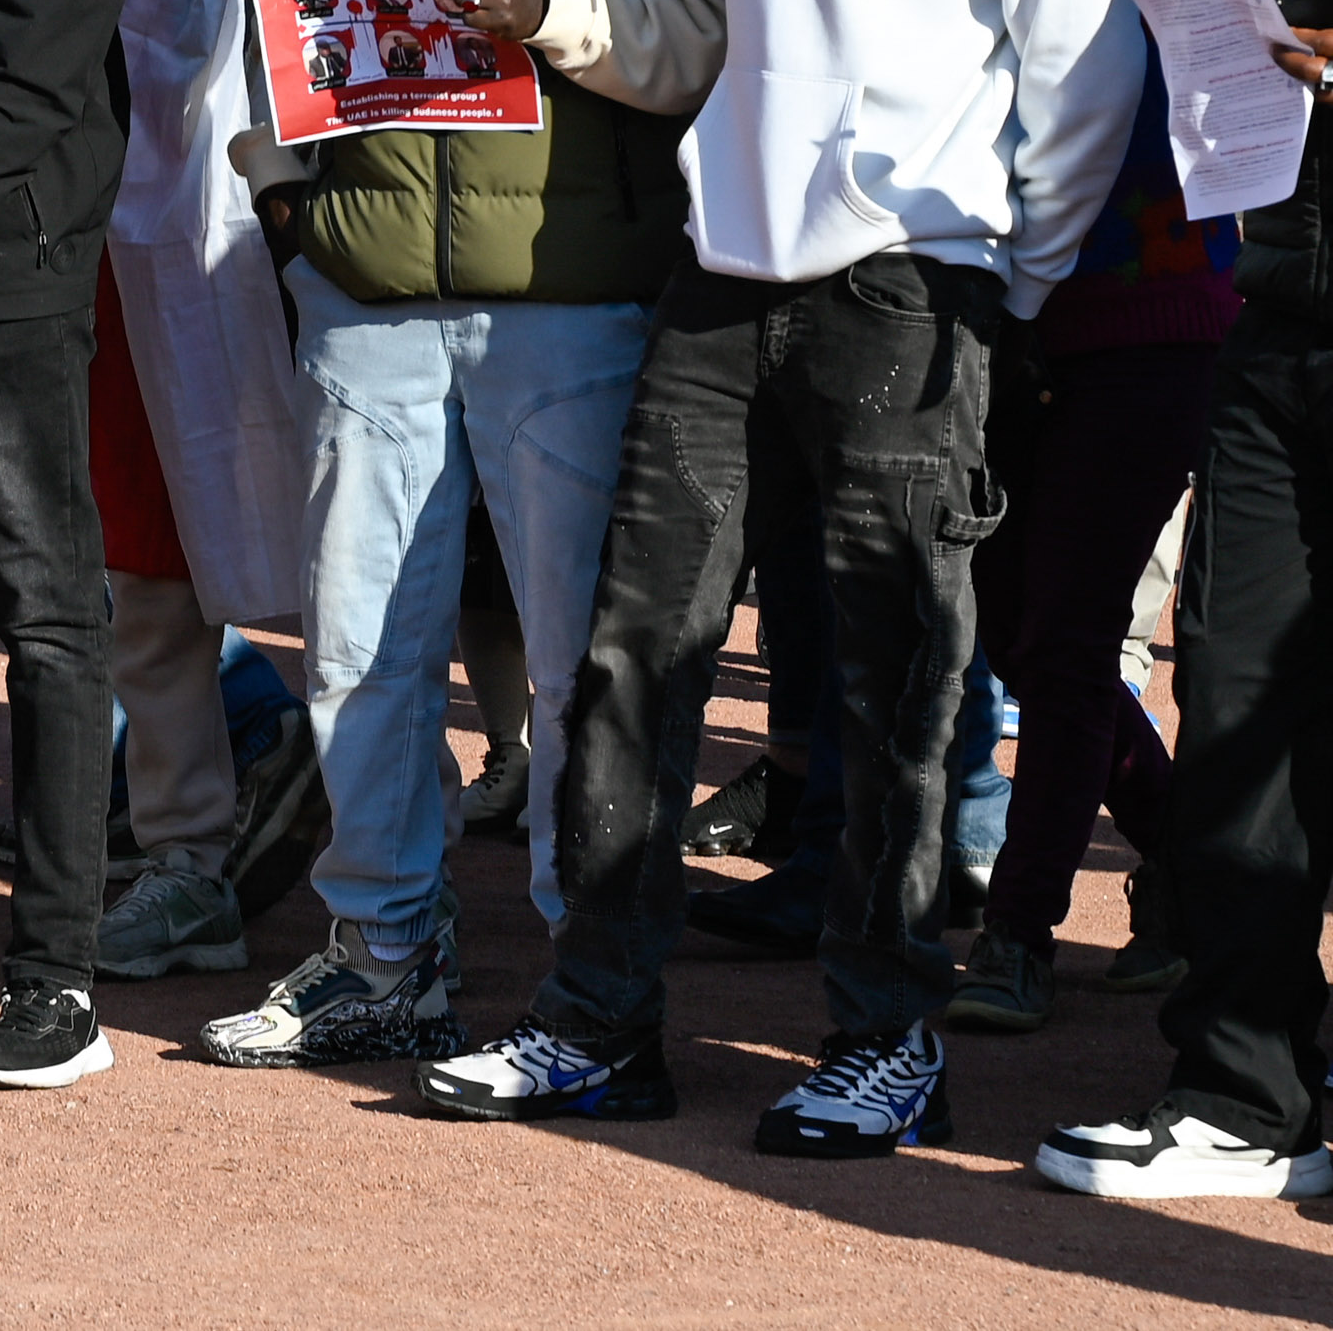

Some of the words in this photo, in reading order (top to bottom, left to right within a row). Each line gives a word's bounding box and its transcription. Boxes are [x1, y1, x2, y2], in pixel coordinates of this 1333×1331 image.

[340, 91, 400, 109] Establishing
[410, 91, 449, 101] terrorist
[450, 92, 478, 103] group
[326, 116, 345, 127] The
[347, 111, 368, 122] UAE
[370, 109, 379, 118] is
[381, 107, 411, 118] killing
[412, 106, 458, 118] Sudanese
[460, 107, 495, 119] people.
